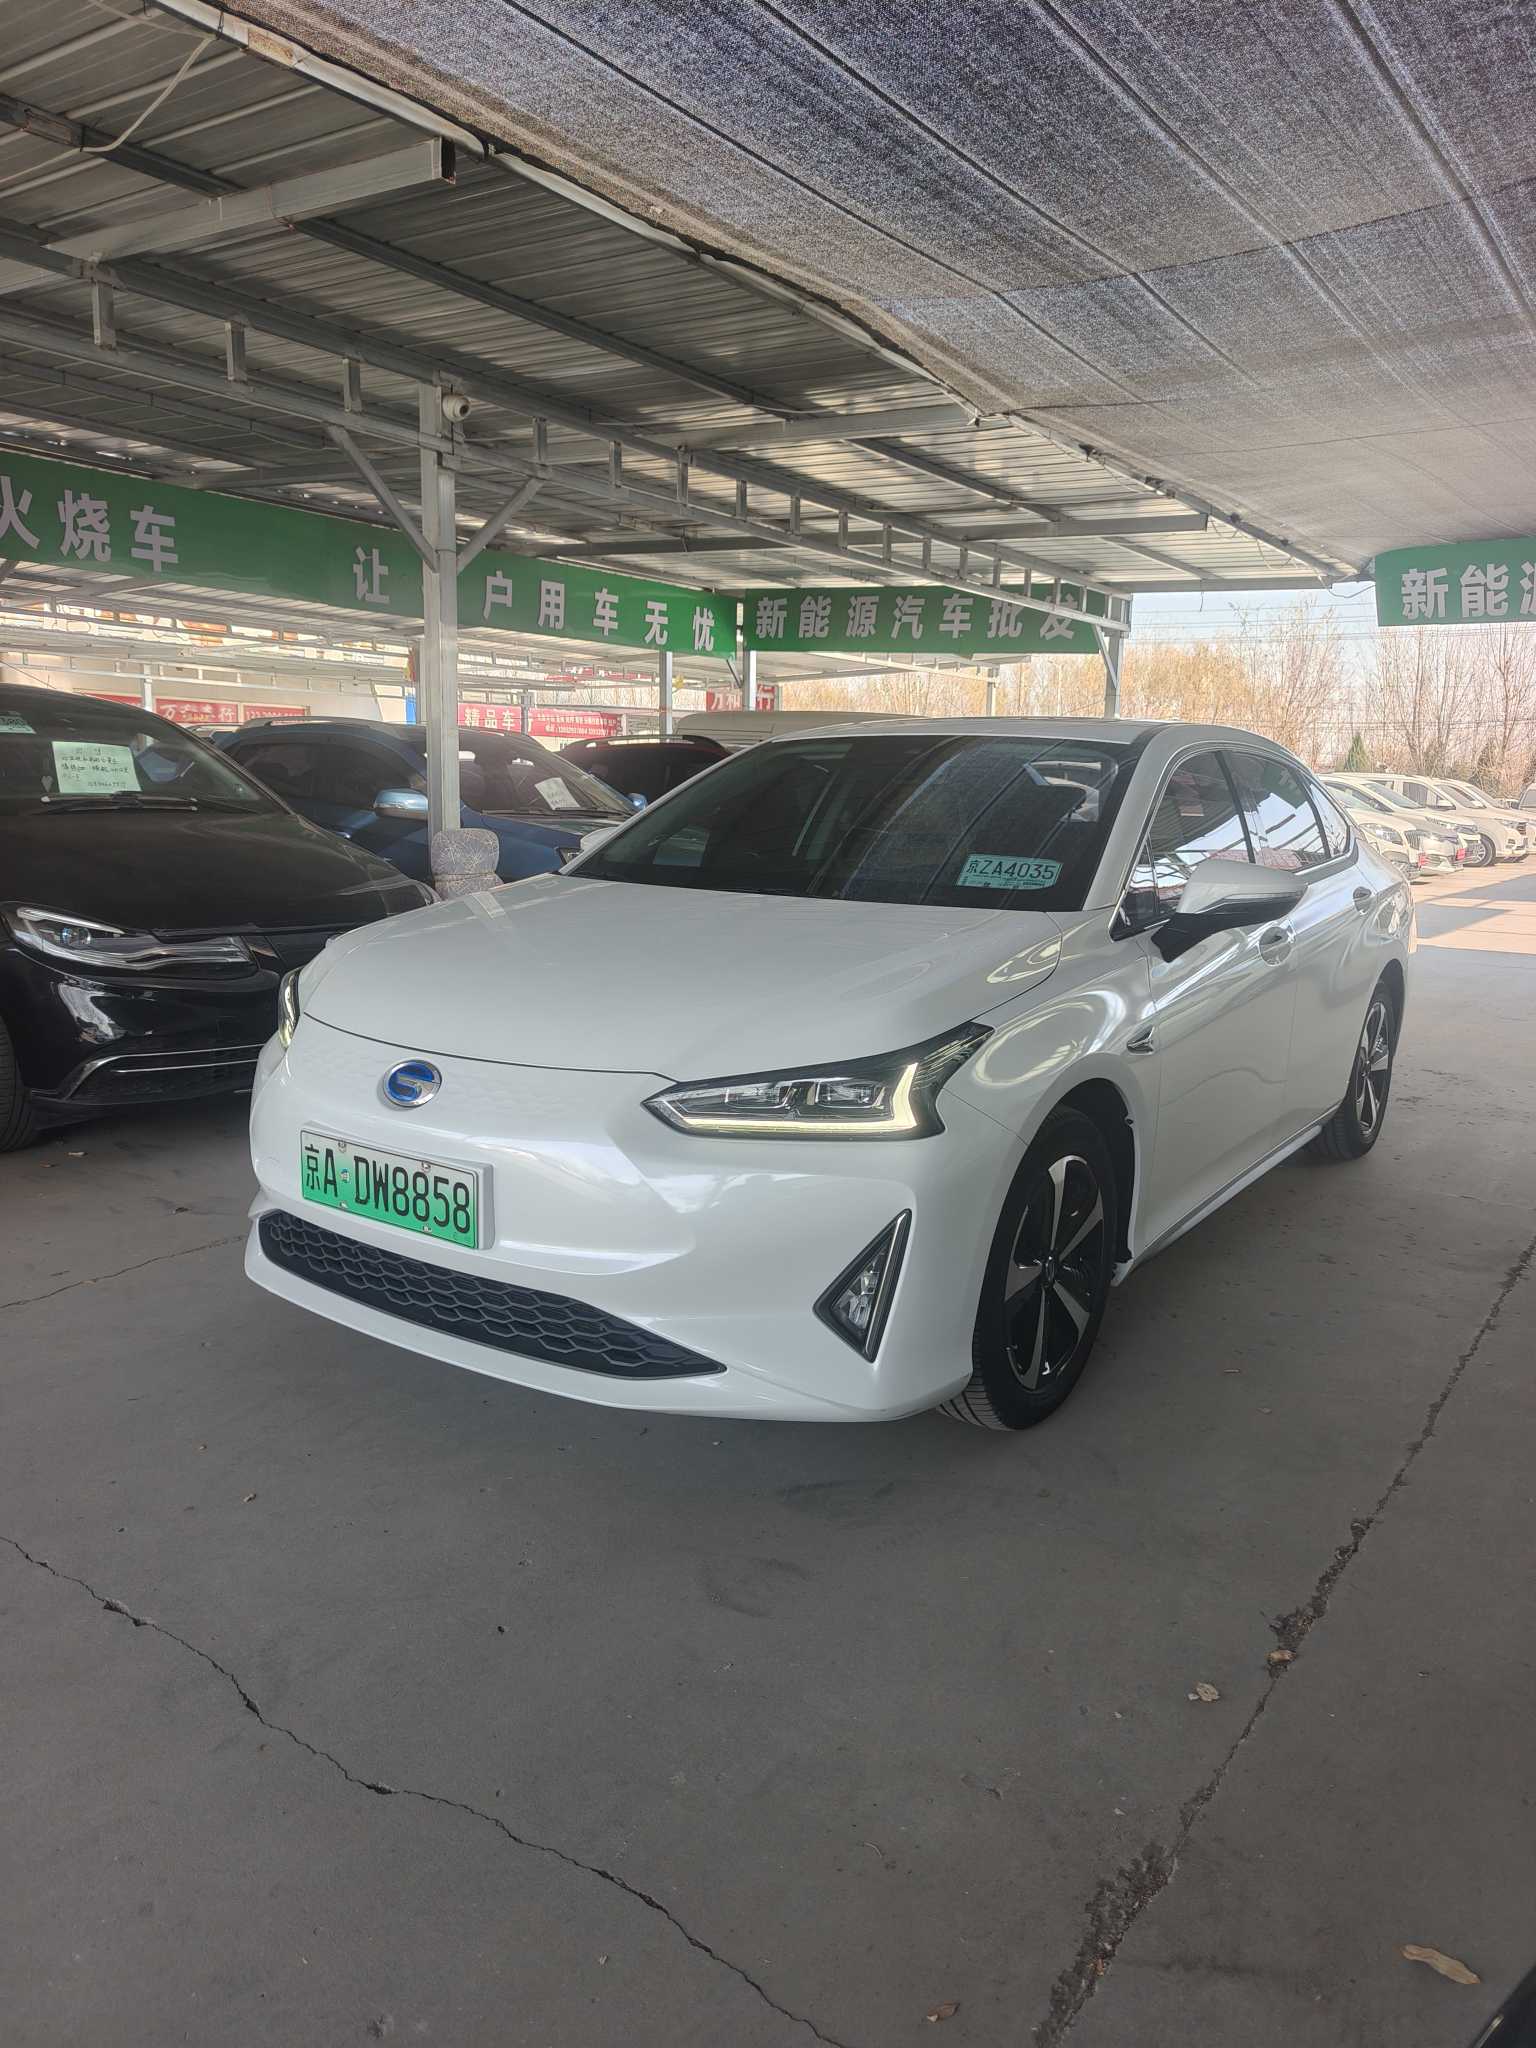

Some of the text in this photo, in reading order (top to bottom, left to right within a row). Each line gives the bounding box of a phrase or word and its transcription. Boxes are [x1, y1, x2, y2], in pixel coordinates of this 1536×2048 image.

[0, 476, 715, 652] 火烧车 让户用车无忧
[756, 592, 1077, 641] 新能源汽车批发
[966, 859, 1057, 880] 京ZA4035
